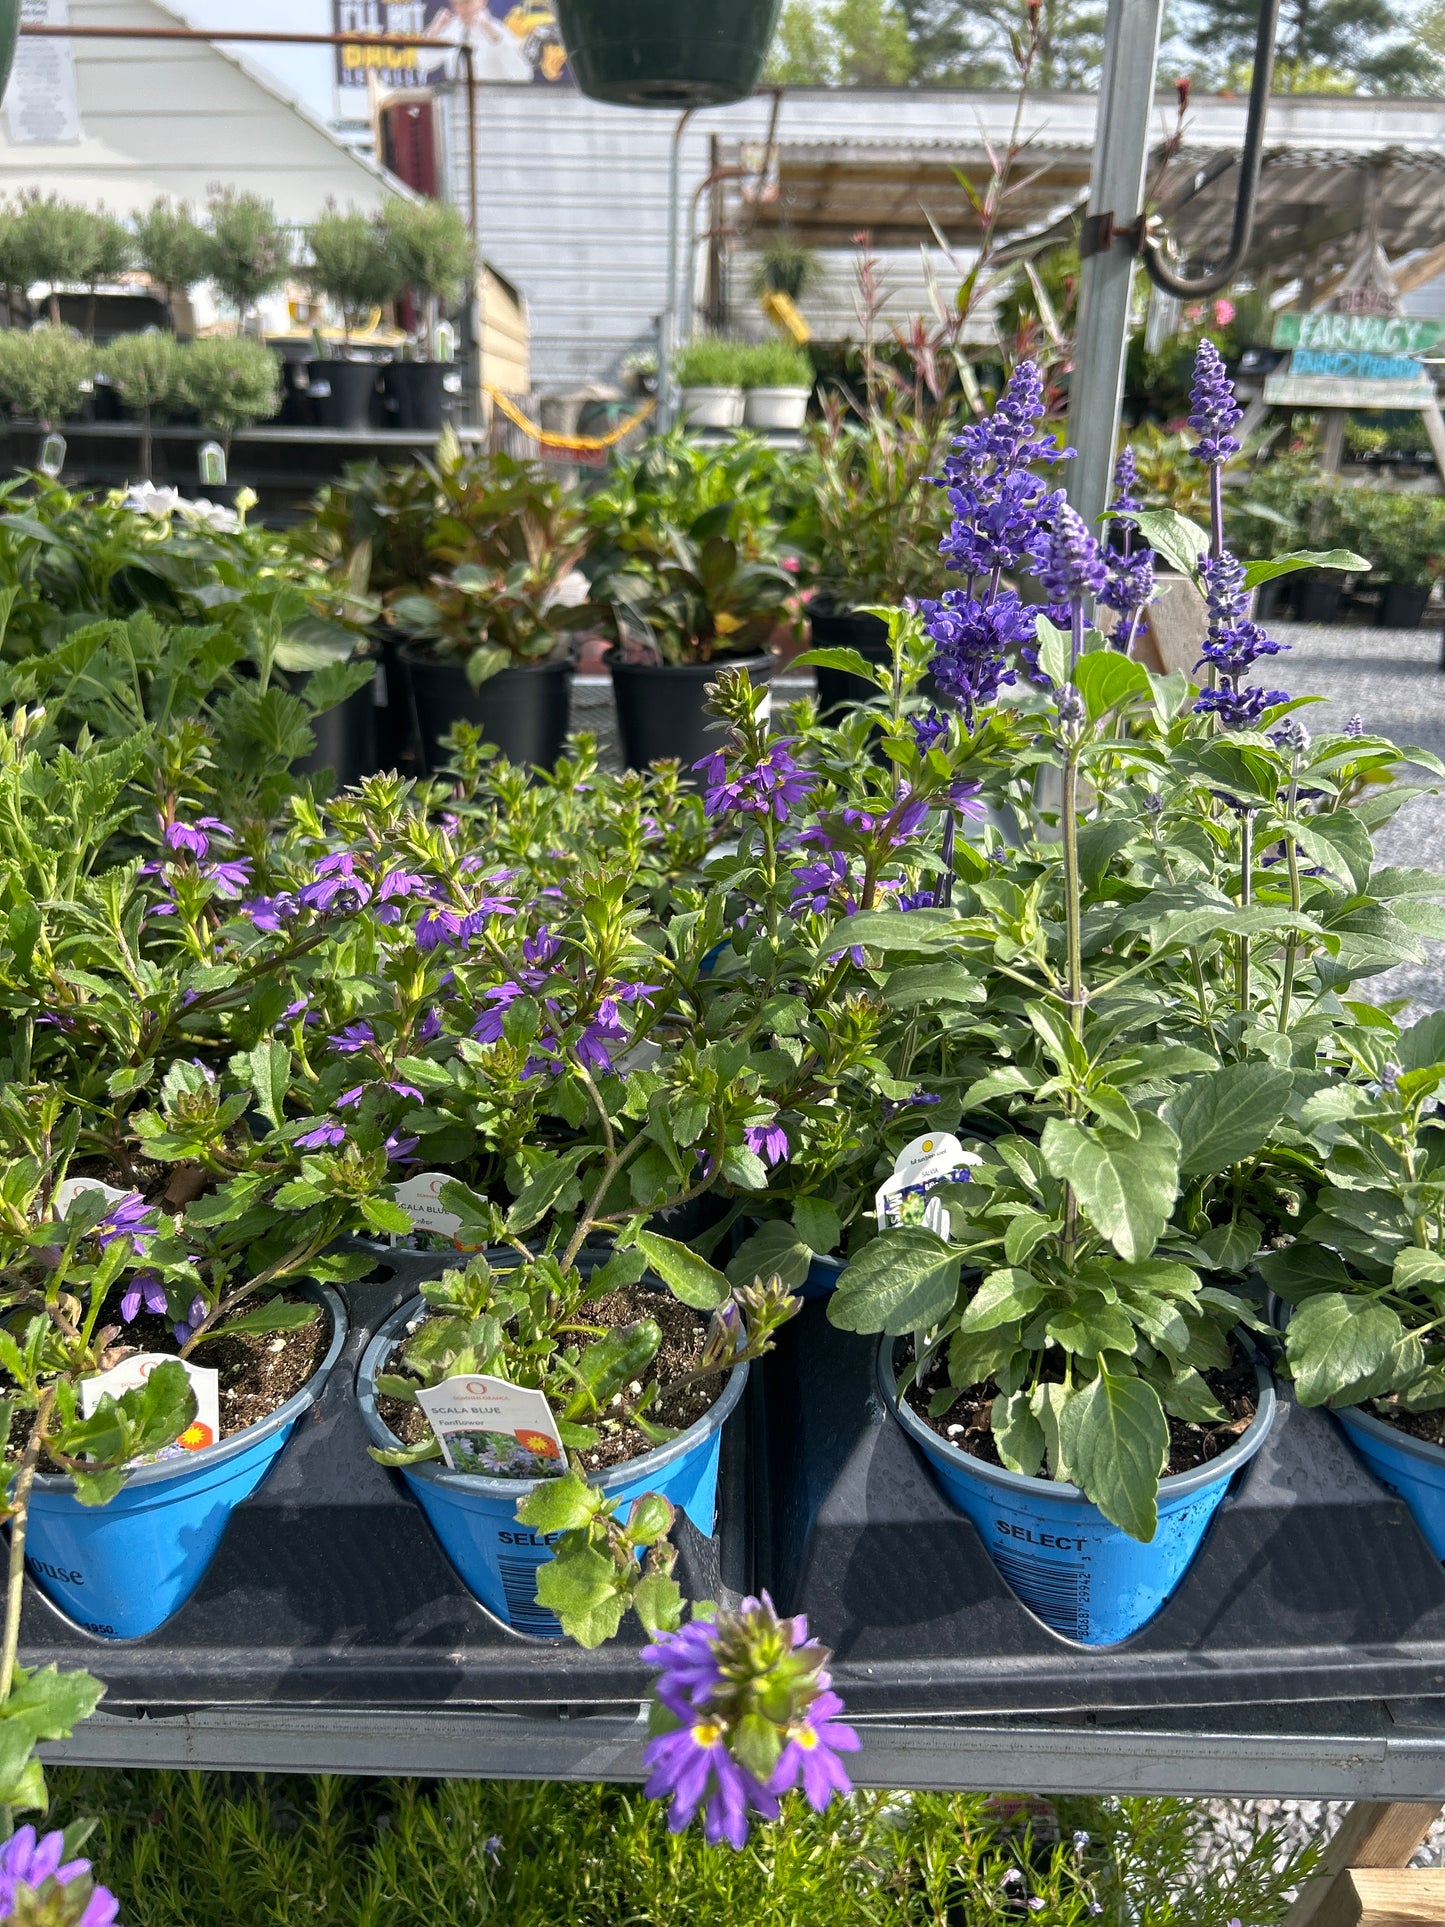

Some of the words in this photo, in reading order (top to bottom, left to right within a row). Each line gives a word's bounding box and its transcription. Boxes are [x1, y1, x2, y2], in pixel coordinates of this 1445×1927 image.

[1299, 313, 1423, 351] FARMACY
[921, 1167, 939, 1178] SALVIA
[398, 1203, 425, 1212] CALA
[497, 1531, 559, 1546] SELE
[996, 1519, 1088, 1552] SELECT
[31, 1556, 85, 1585] ouse
[1078, 1573, 1091, 1603] 29942
